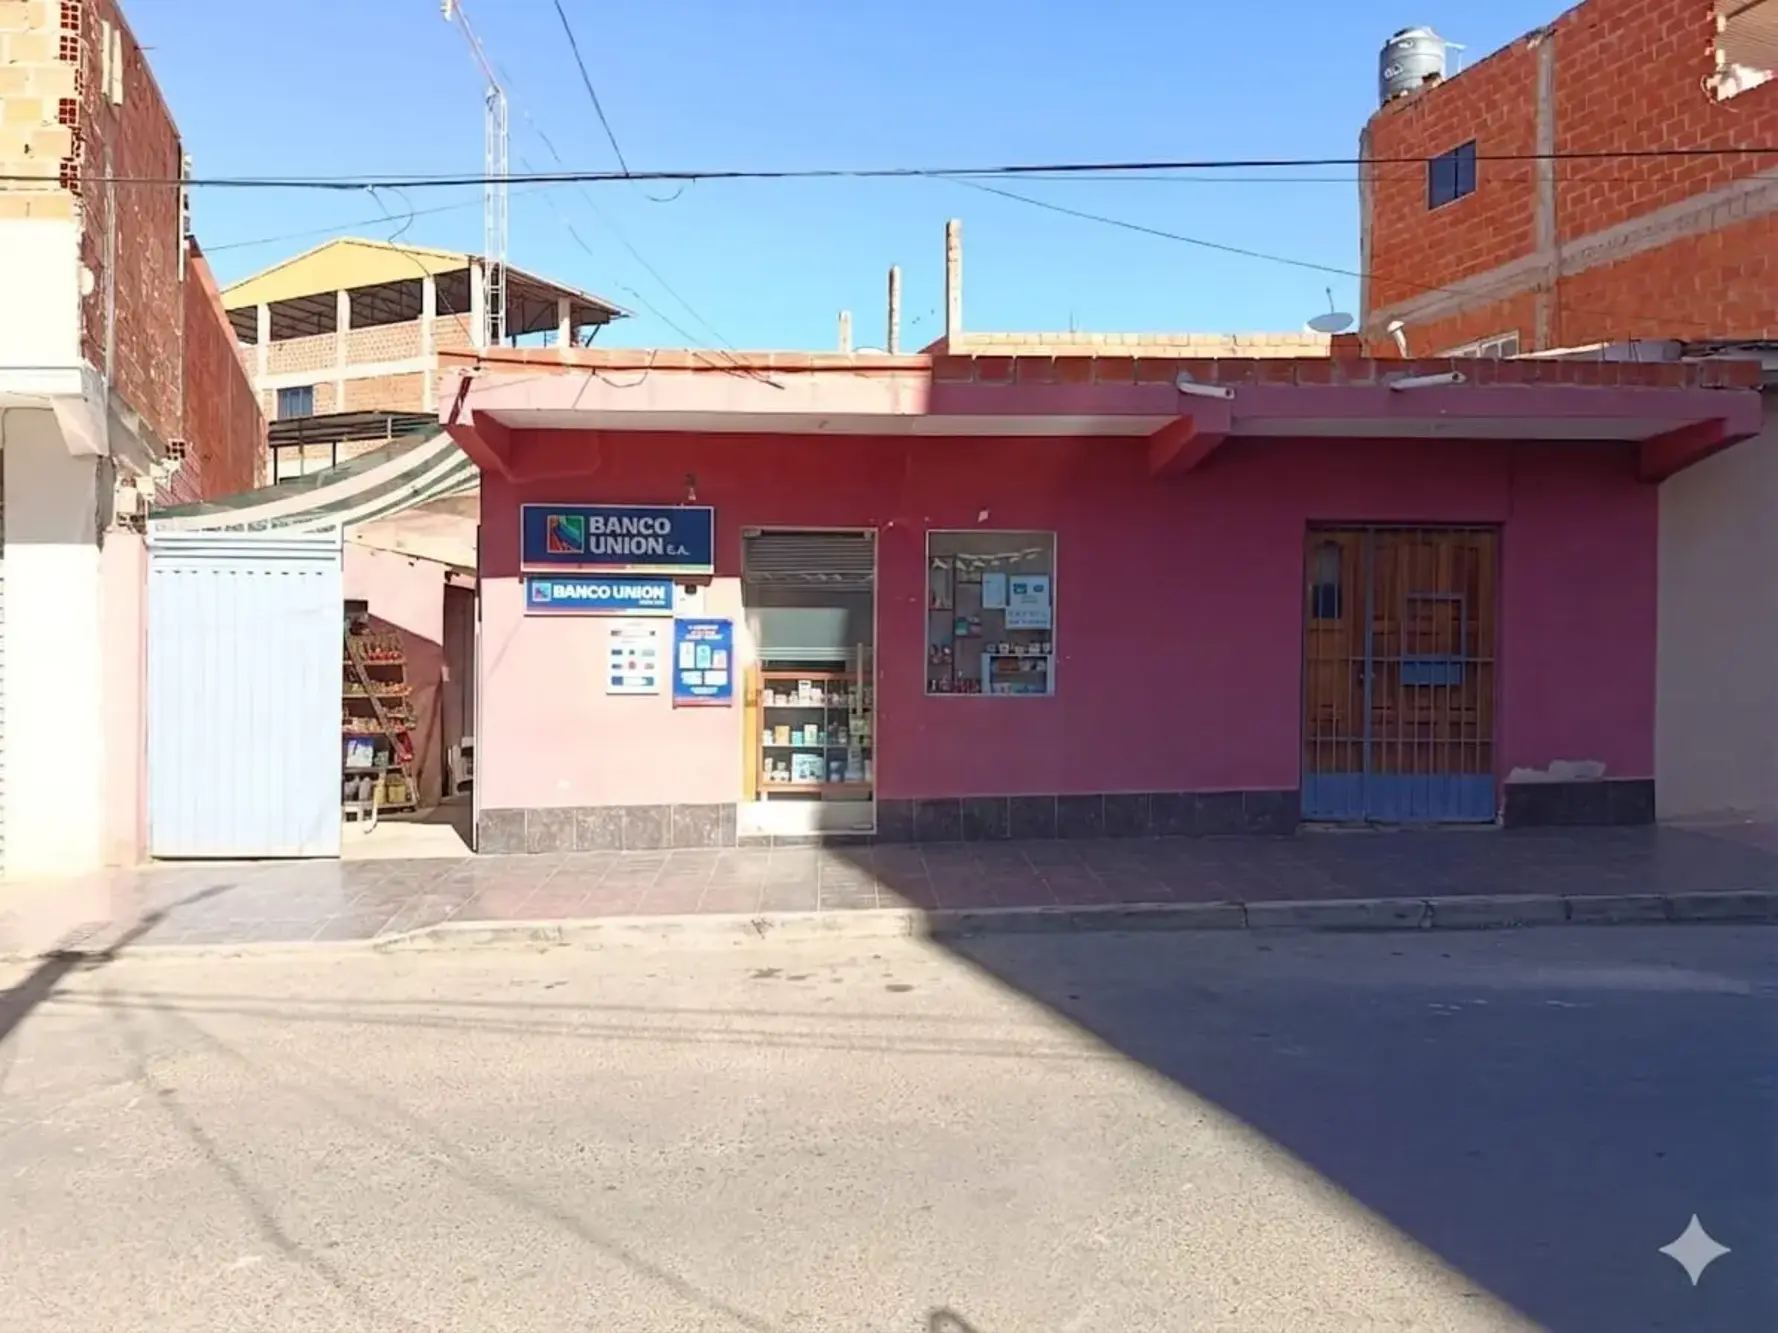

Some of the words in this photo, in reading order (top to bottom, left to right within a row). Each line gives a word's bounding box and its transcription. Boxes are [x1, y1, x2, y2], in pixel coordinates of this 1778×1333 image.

[589, 516, 672, 535] BANCO
[589, 535, 664, 555] UNION
[552, 584, 611, 599] BANCO
[612, 585, 666, 600] UNION
